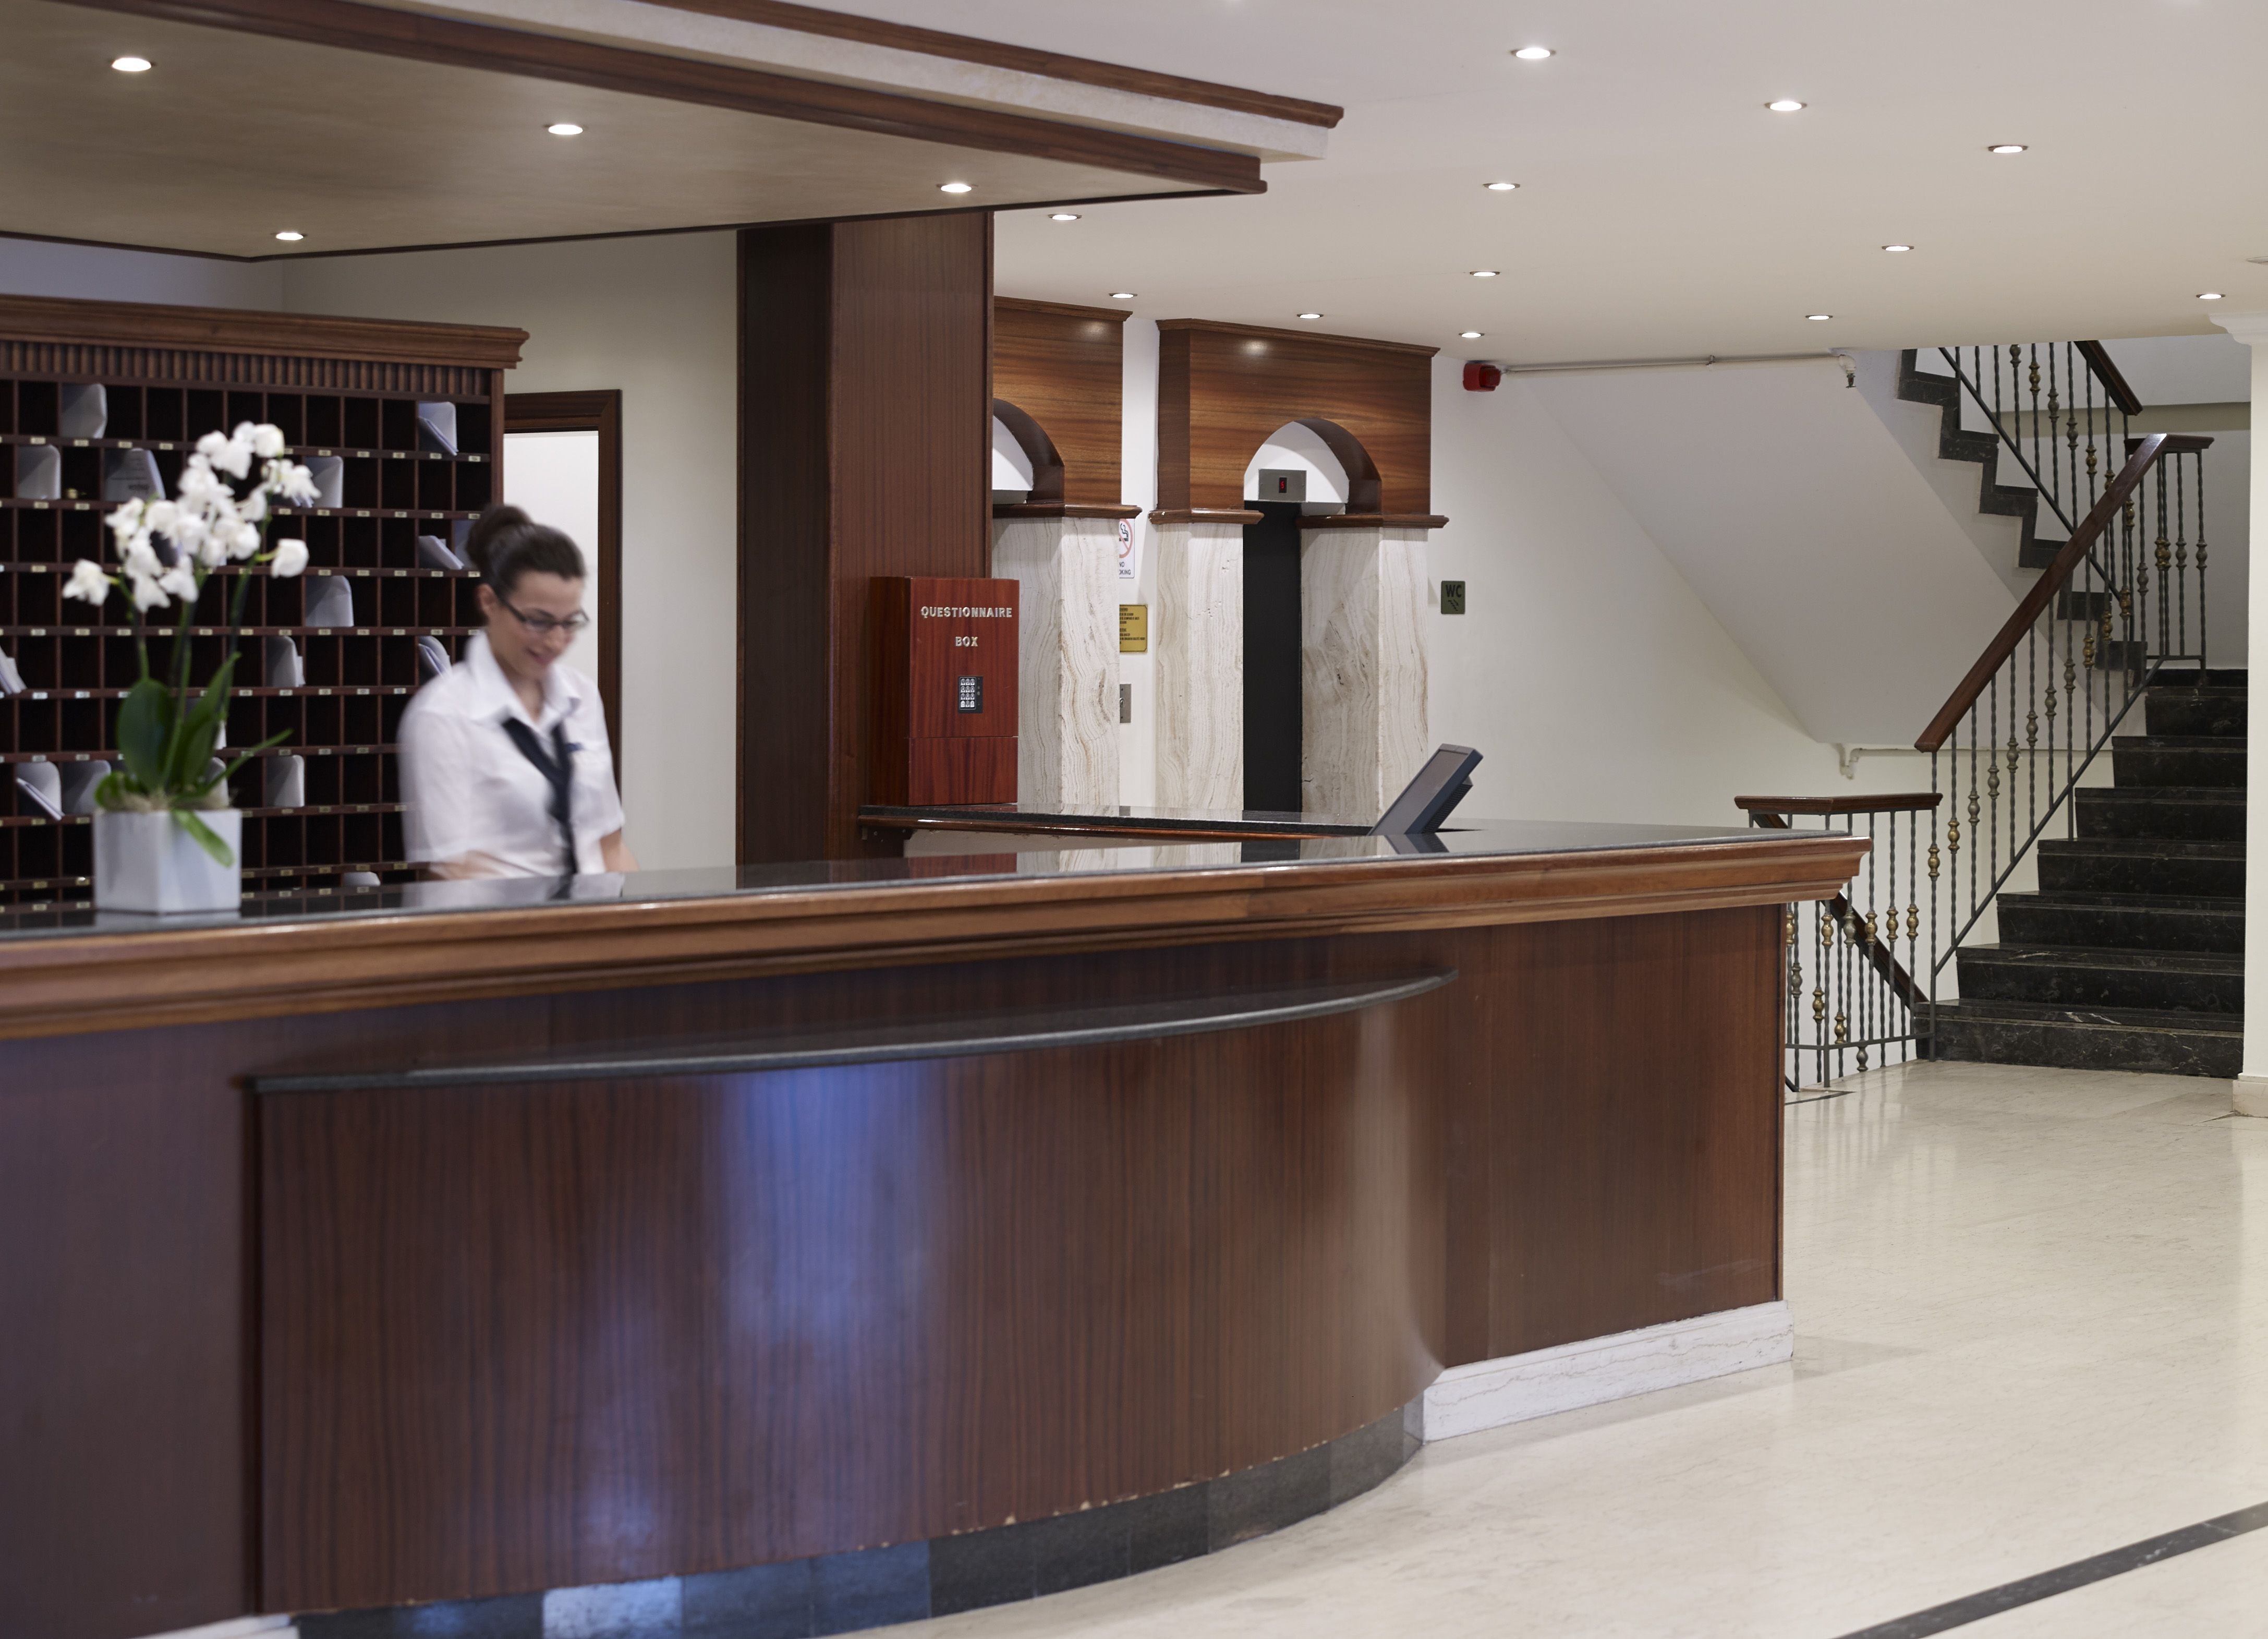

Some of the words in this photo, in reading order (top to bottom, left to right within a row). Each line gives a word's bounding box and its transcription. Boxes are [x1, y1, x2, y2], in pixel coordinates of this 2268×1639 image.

[1445, 584, 1462, 598] WC
[921, 606, 1012, 619] QUESTIONNAIRE
[955, 636, 978, 647] BOX
